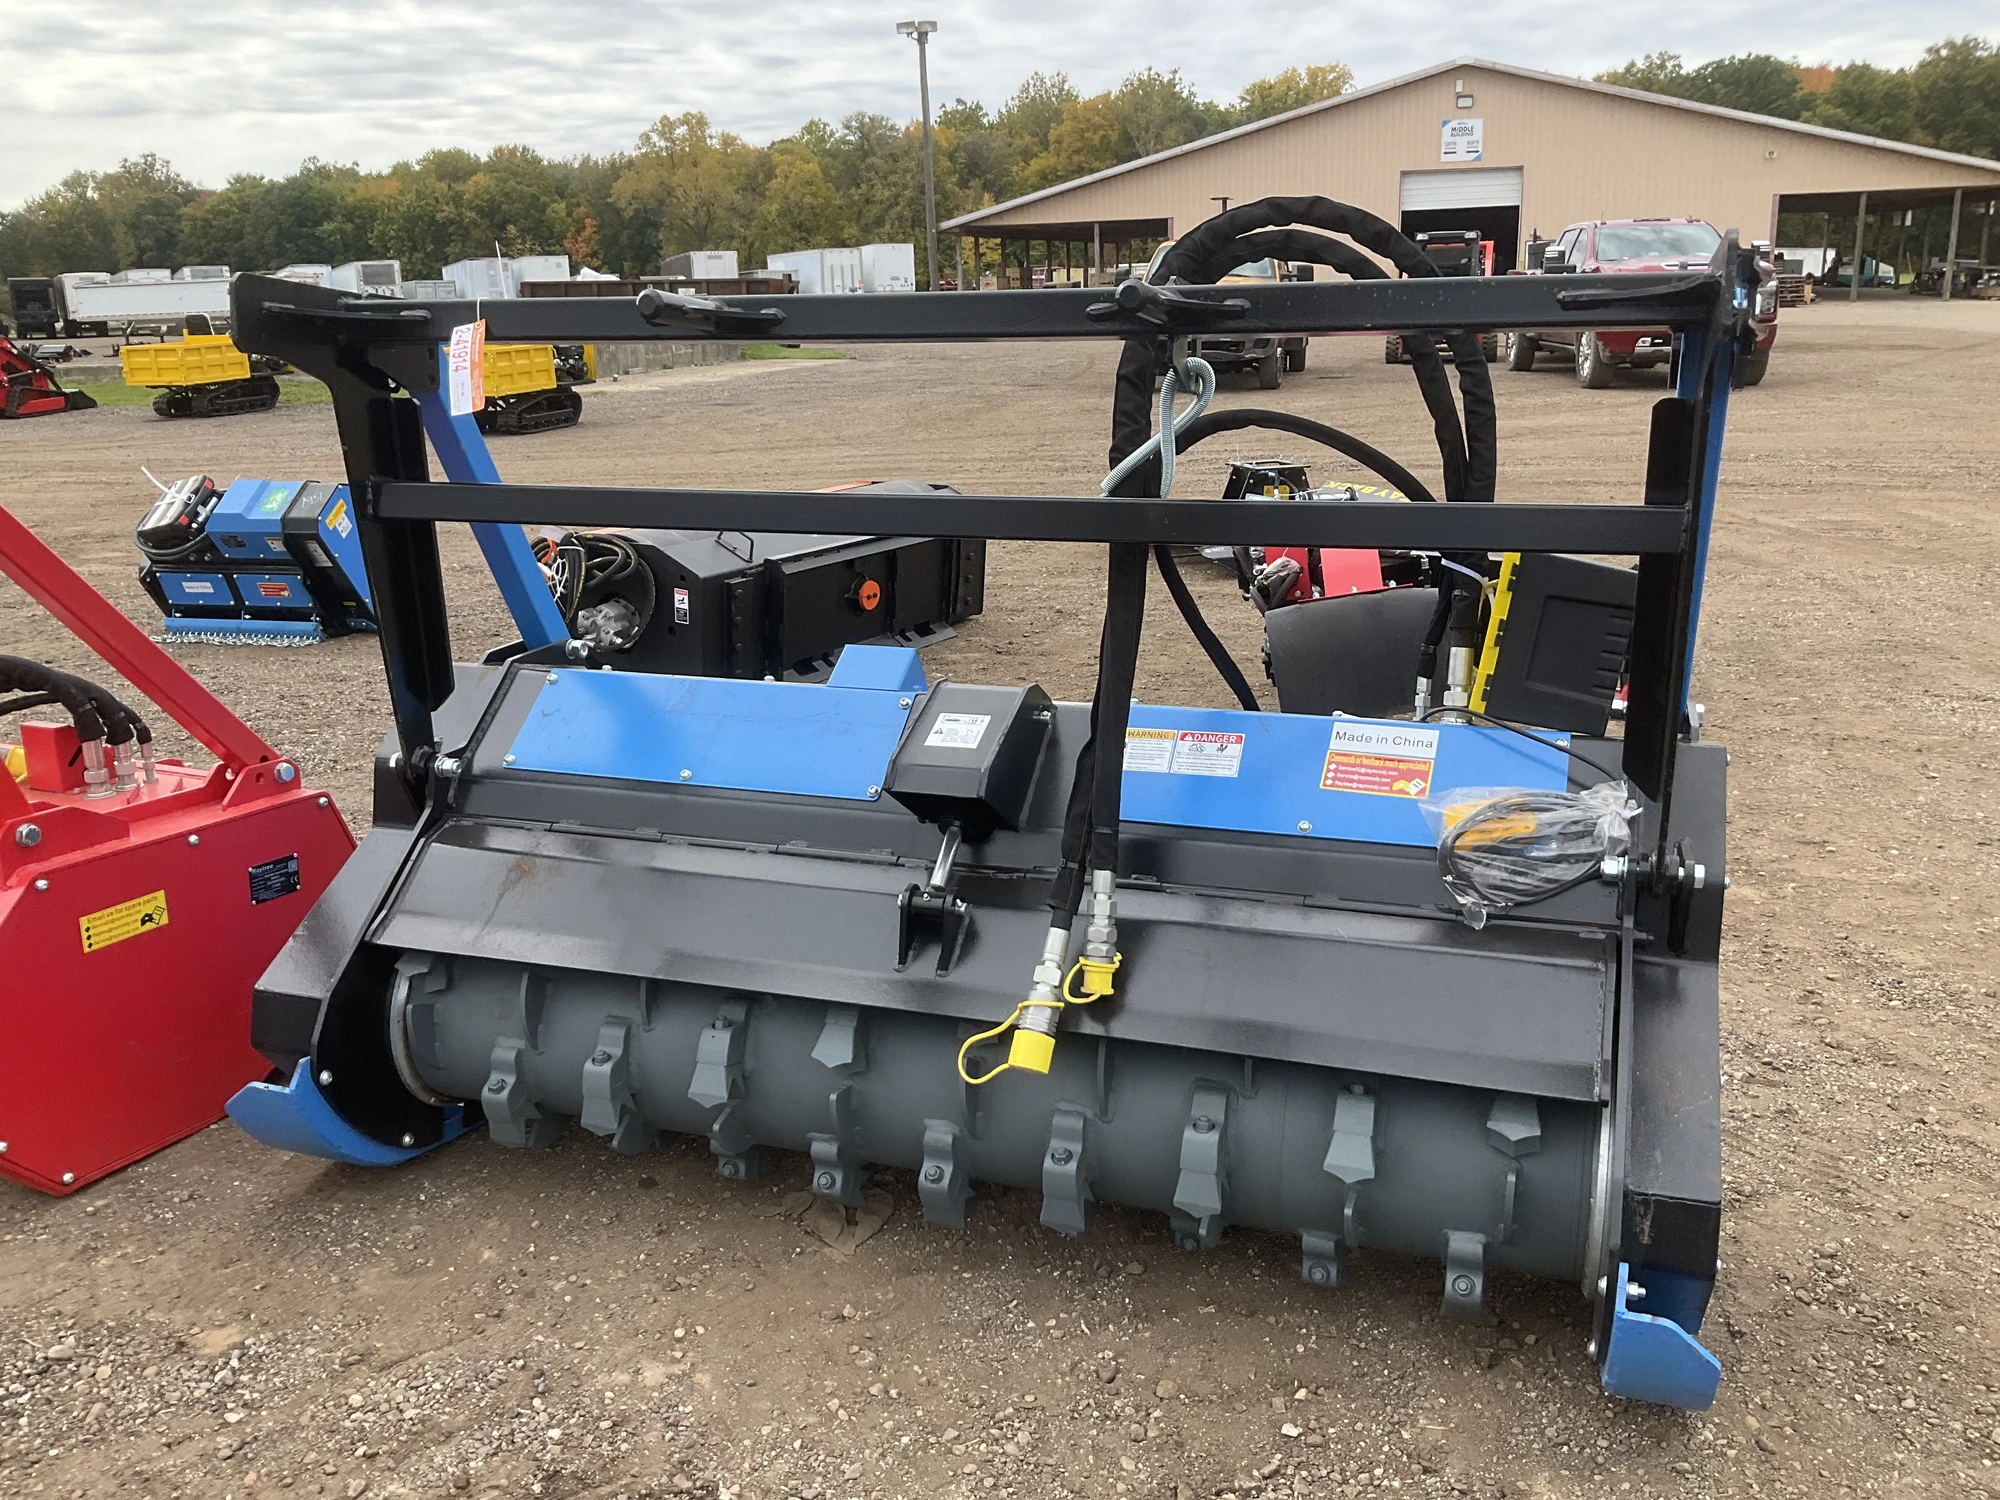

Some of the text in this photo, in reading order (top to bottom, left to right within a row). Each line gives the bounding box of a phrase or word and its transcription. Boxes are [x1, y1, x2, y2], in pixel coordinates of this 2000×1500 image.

[452, 328, 471, 372] 2-41914
[1128, 730, 1170, 739] WARNING
[1194, 733, 1237, 743] DANGER
[1335, 731, 1434, 749] Made in China
[1330, 753, 1355, 763] Comments
[1362, 756, 1384, 766] feedback
[1384, 759, 1398, 767] much
[1399, 760, 1430, 771] appreciated!
[87, 896, 158, 924] Email us for spare parts
